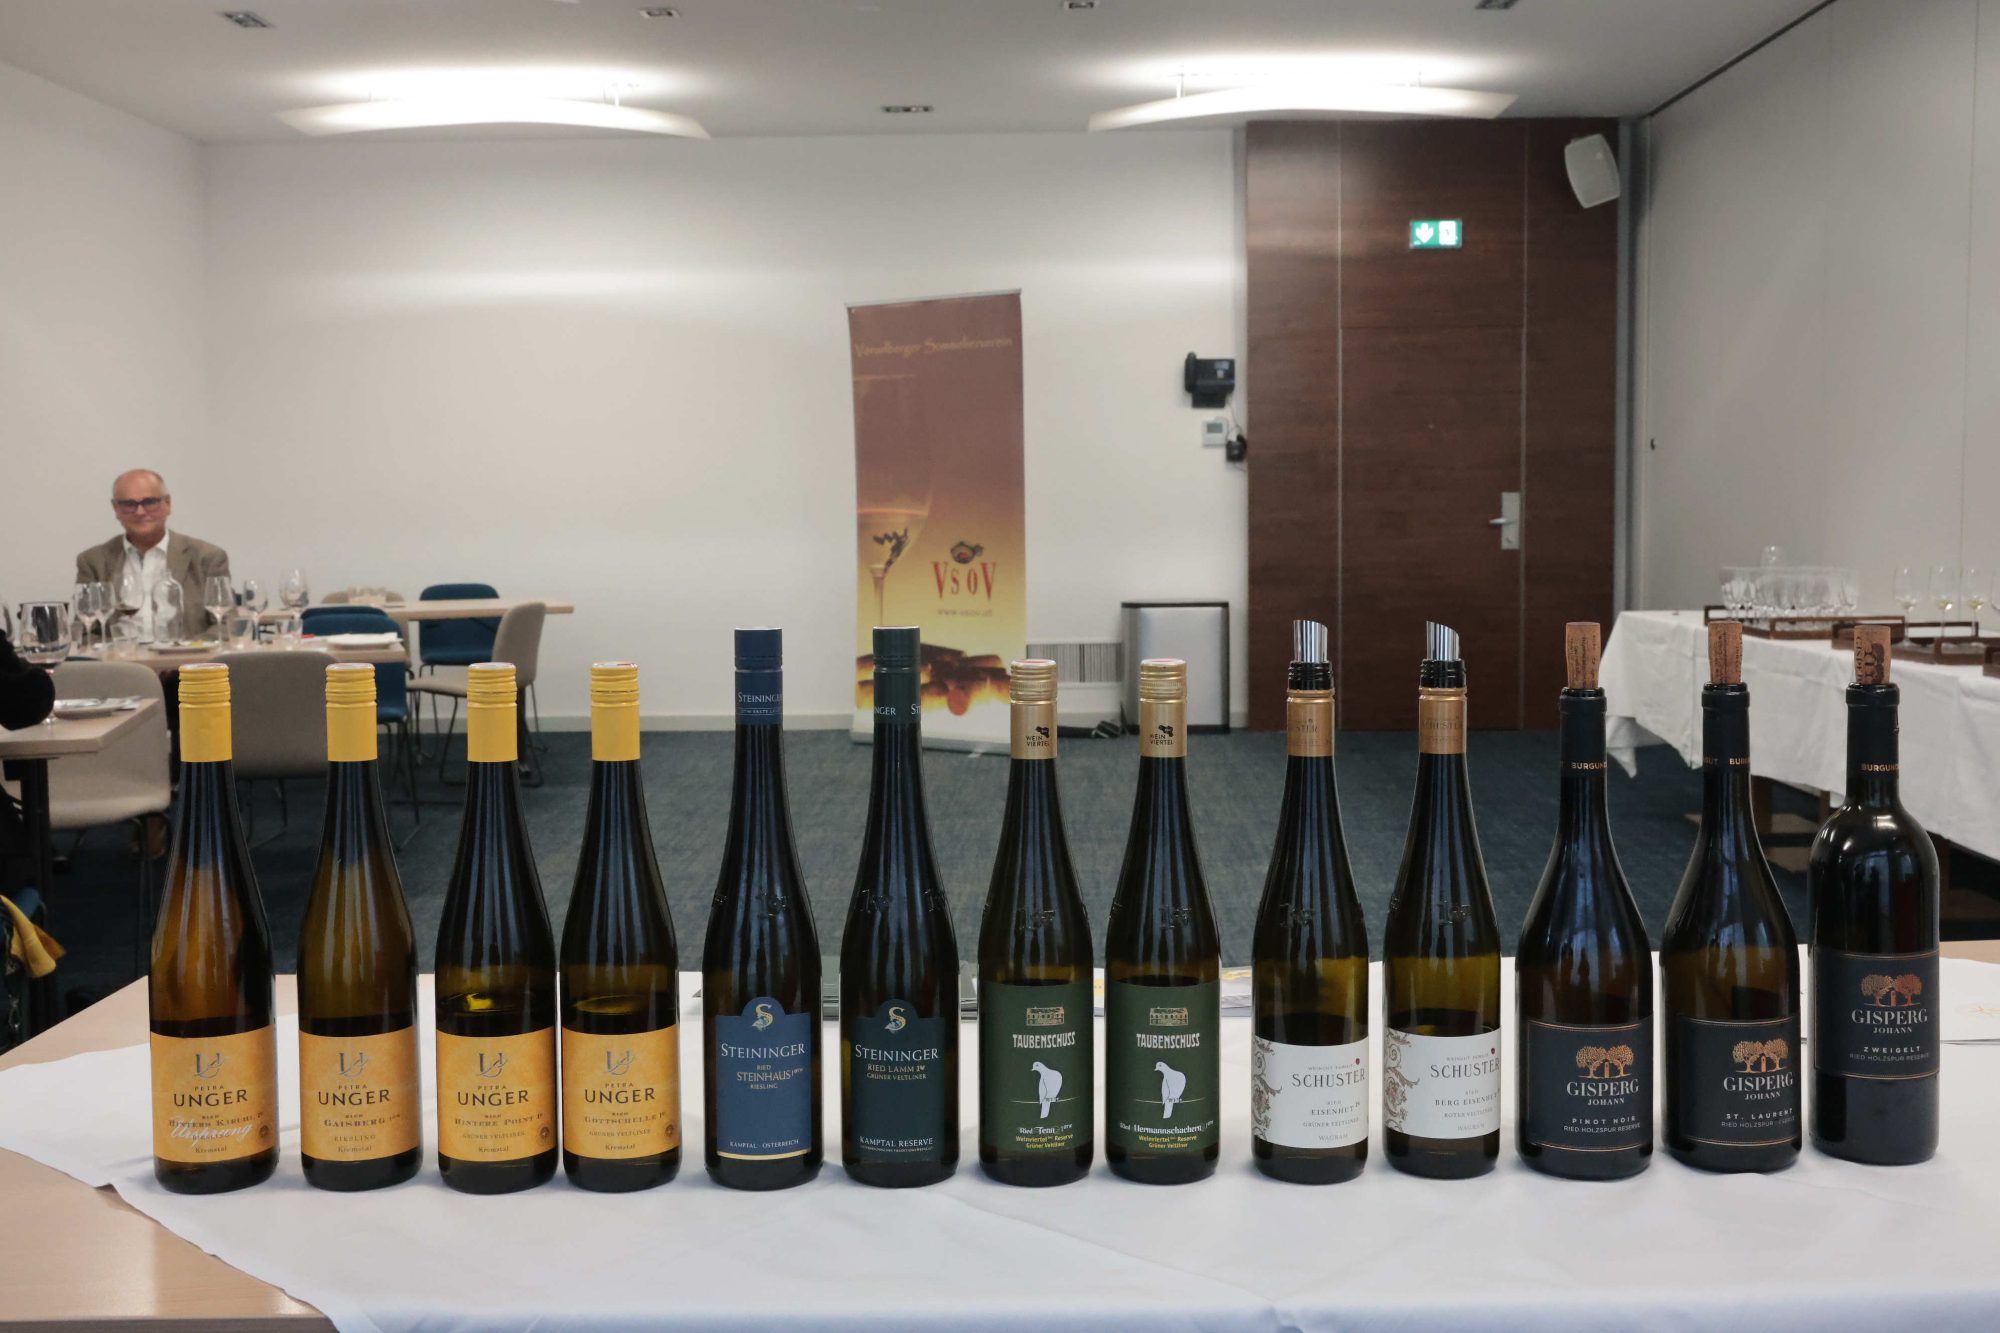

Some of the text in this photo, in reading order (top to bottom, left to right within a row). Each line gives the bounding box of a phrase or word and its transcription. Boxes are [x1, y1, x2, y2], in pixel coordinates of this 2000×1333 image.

[1851, 1008, 1928, 1025] GISPERG
[1012, 1031, 1076, 1049] TAUBENSCHUSS
[1136, 1032, 1200, 1049] TAUBENSCHUSS
[721, 1042, 805, 1059] STEININGER
[855, 1044, 939, 1062] STEININGER
[1863, 1045, 1921, 1054] ZWEIGELT
[867, 1063, 886, 1072] RIED
[888, 1065, 914, 1073] LAMM
[1430, 1057, 1500, 1079] SCHUSTER
[736, 1069, 791, 1082] STEINHAUS
[892, 1073, 927, 1081] VELTLINER
[1291, 1068, 1365, 1088] SCHUSTER
[1723, 1071, 1793, 1092] GISPERG
[1566, 1079, 1639, 1097] GISPERG
[173, 1089, 248, 1107] UNGER
[318, 1089, 390, 1106] UNGER
[457, 1090, 529, 1106] UNGER
[584, 1087, 656, 1104] UNGER
[1744, 1091, 1781, 1101] JOHANN
[1587, 1097, 1625, 1106] JOHANN
[1613, 1115, 1636, 1124] NOIR
[1751, 1108, 1793, 1120] LAURENT
[323, 1117, 386, 1128] GAISBERG
[1739, 1120, 1774, 1128] HOLZSPUR
[1019, 1126, 1033, 1134] Ried
[1563, 1125, 1580, 1133] RIED
[334, 1134, 376, 1142] RIESLING
[859, 1136, 934, 1147] KAMPTAL RESERVE
[1054, 1133, 1074, 1141] Reserve
[1318, 1133, 1348, 1141] WAGRAM
[729, 1141, 758, 1149] KAMPTAL
